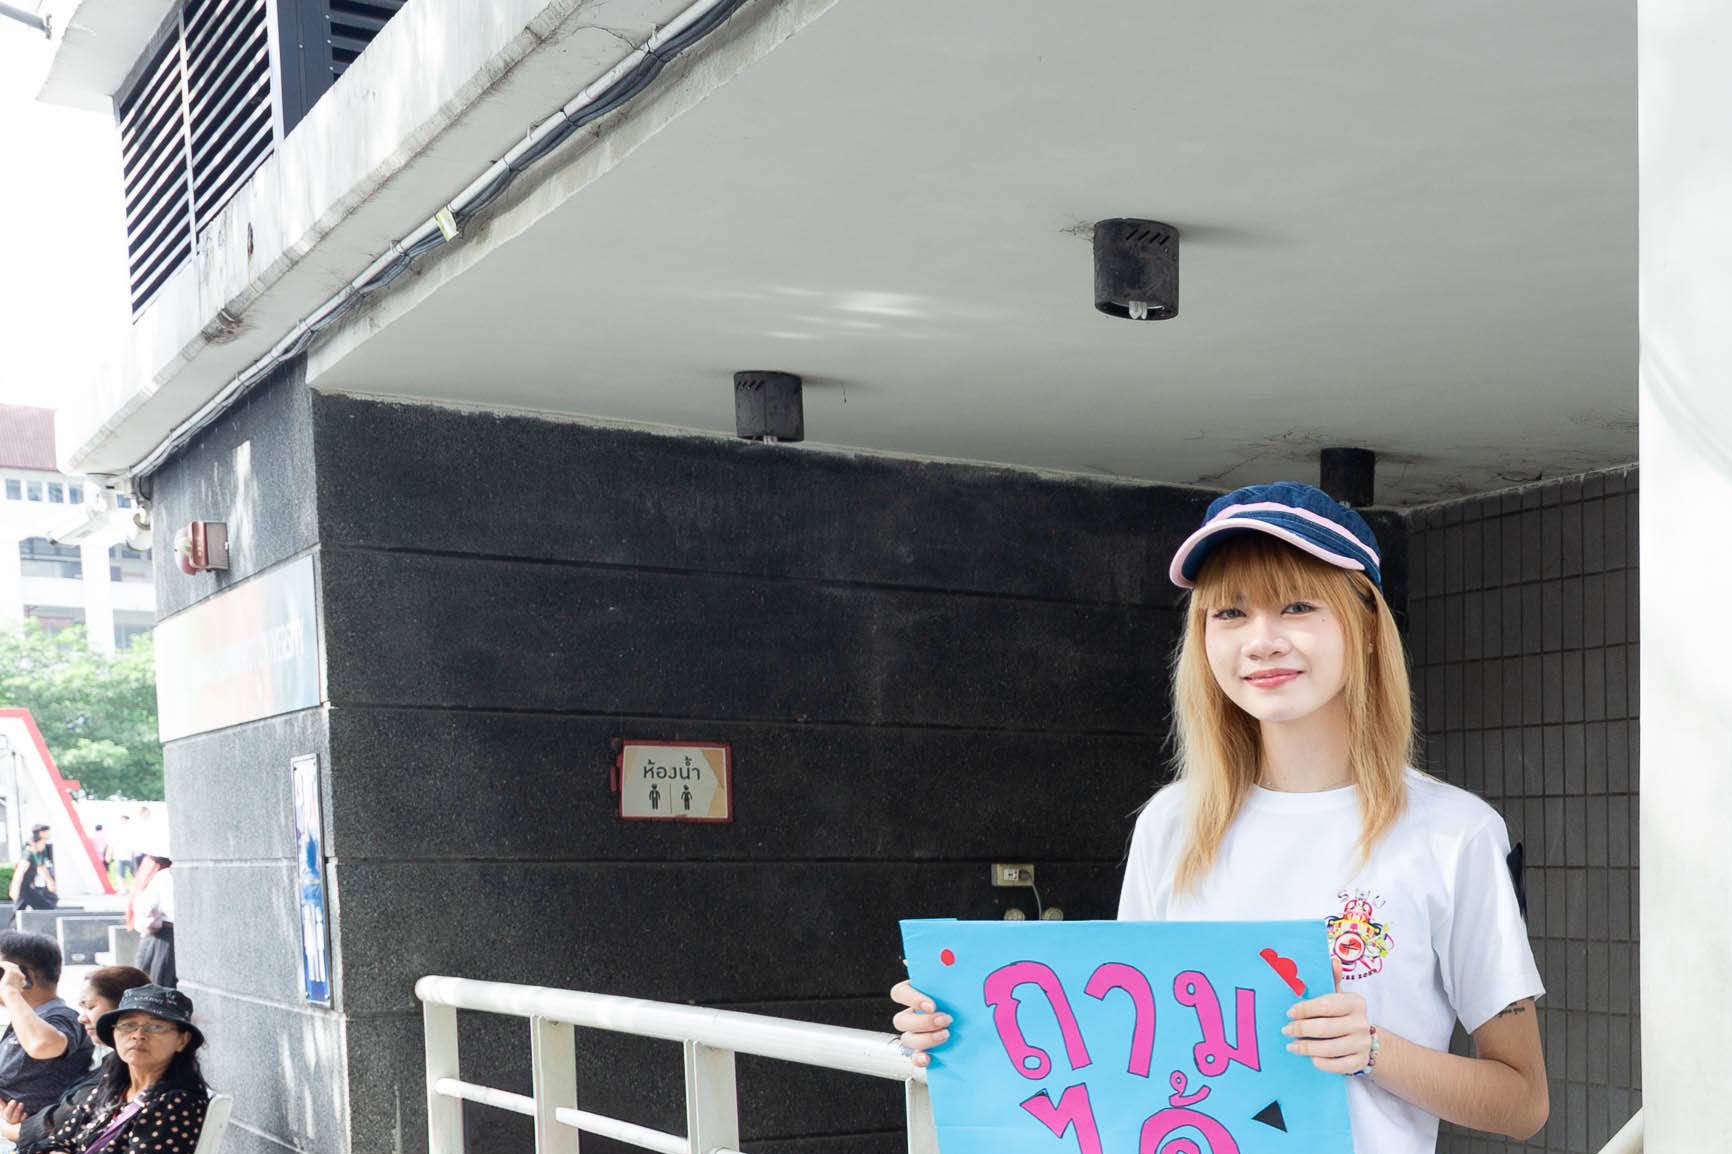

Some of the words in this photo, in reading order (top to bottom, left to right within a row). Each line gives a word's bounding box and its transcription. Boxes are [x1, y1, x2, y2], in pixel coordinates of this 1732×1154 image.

[643, 756, 701, 780] ห้องน้ำ
[984, 961, 1261, 1080] ถาม
